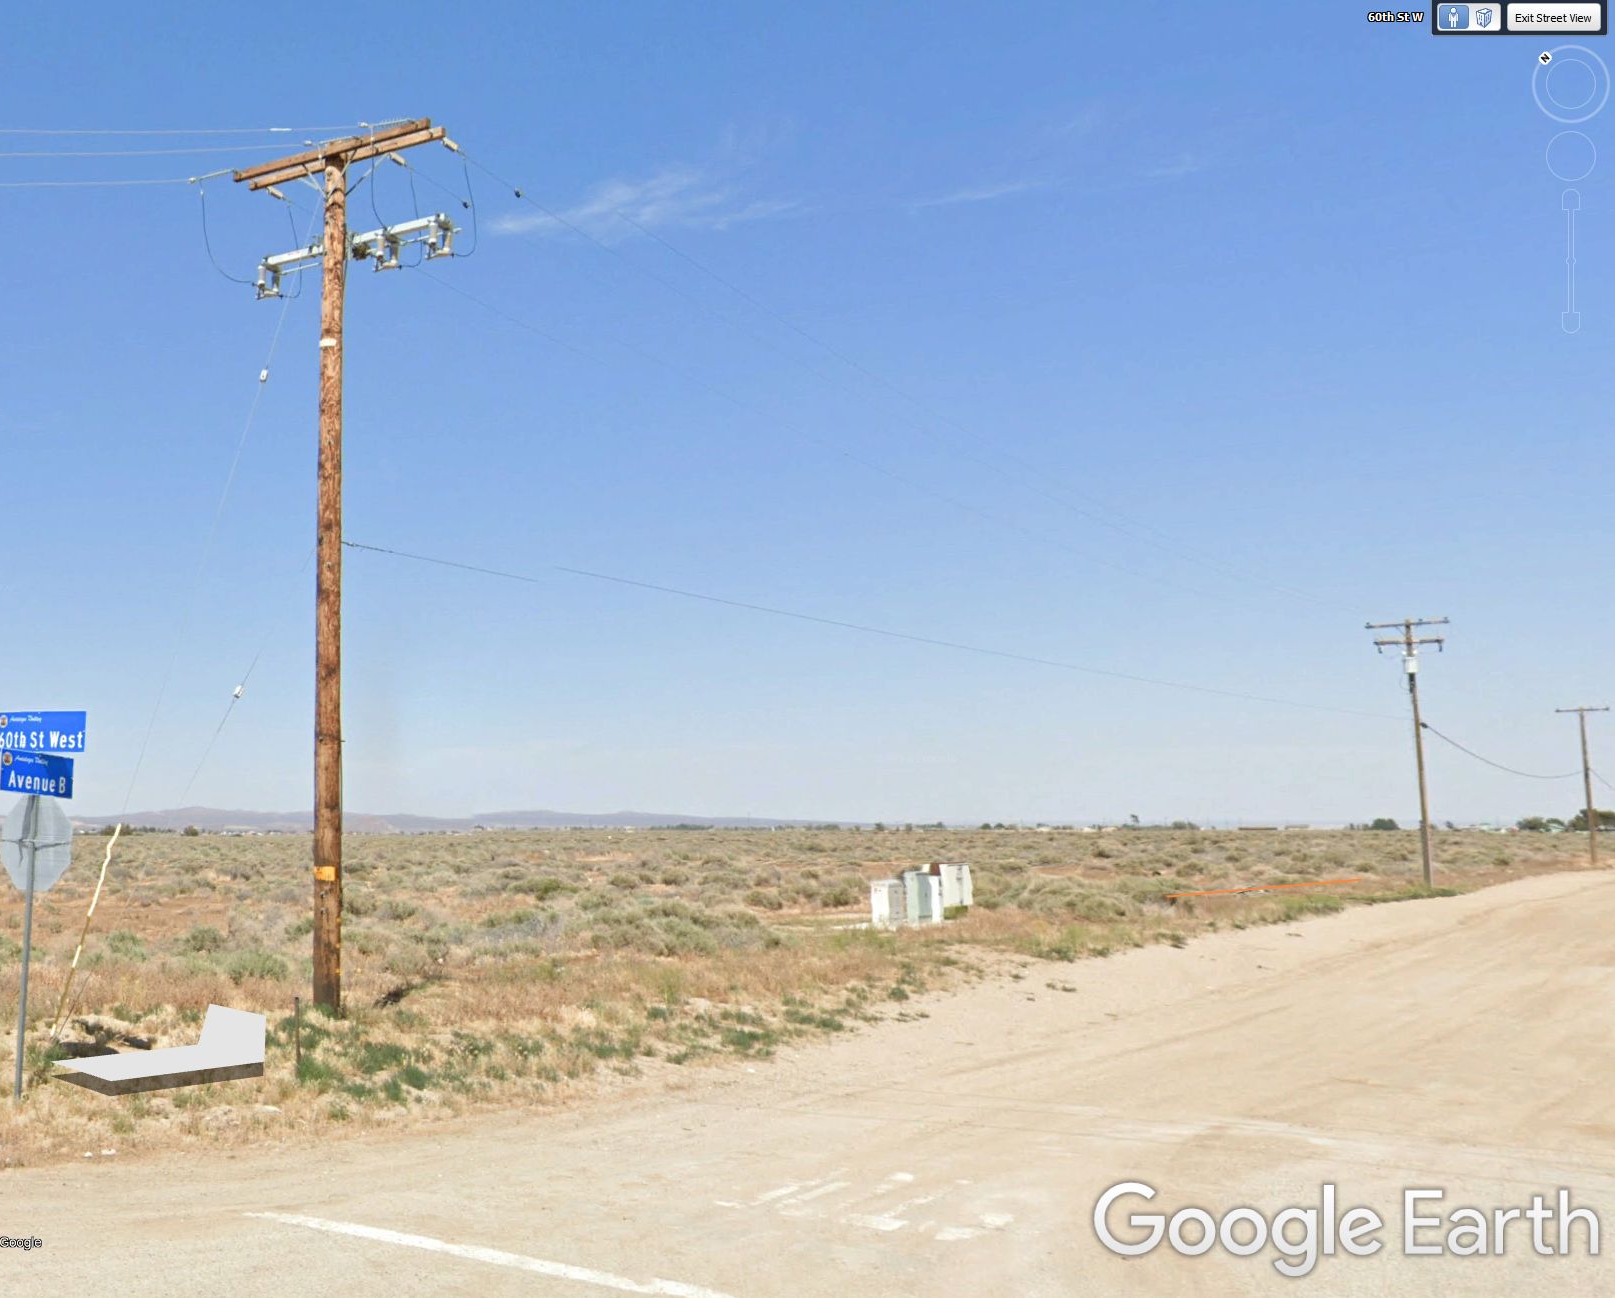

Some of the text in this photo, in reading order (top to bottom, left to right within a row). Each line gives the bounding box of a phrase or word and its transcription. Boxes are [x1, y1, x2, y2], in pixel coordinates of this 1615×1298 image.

[30, 731, 44, 749] St
[50, 731, 83, 749] West
[8, 769, 66, 794] Avenue B
